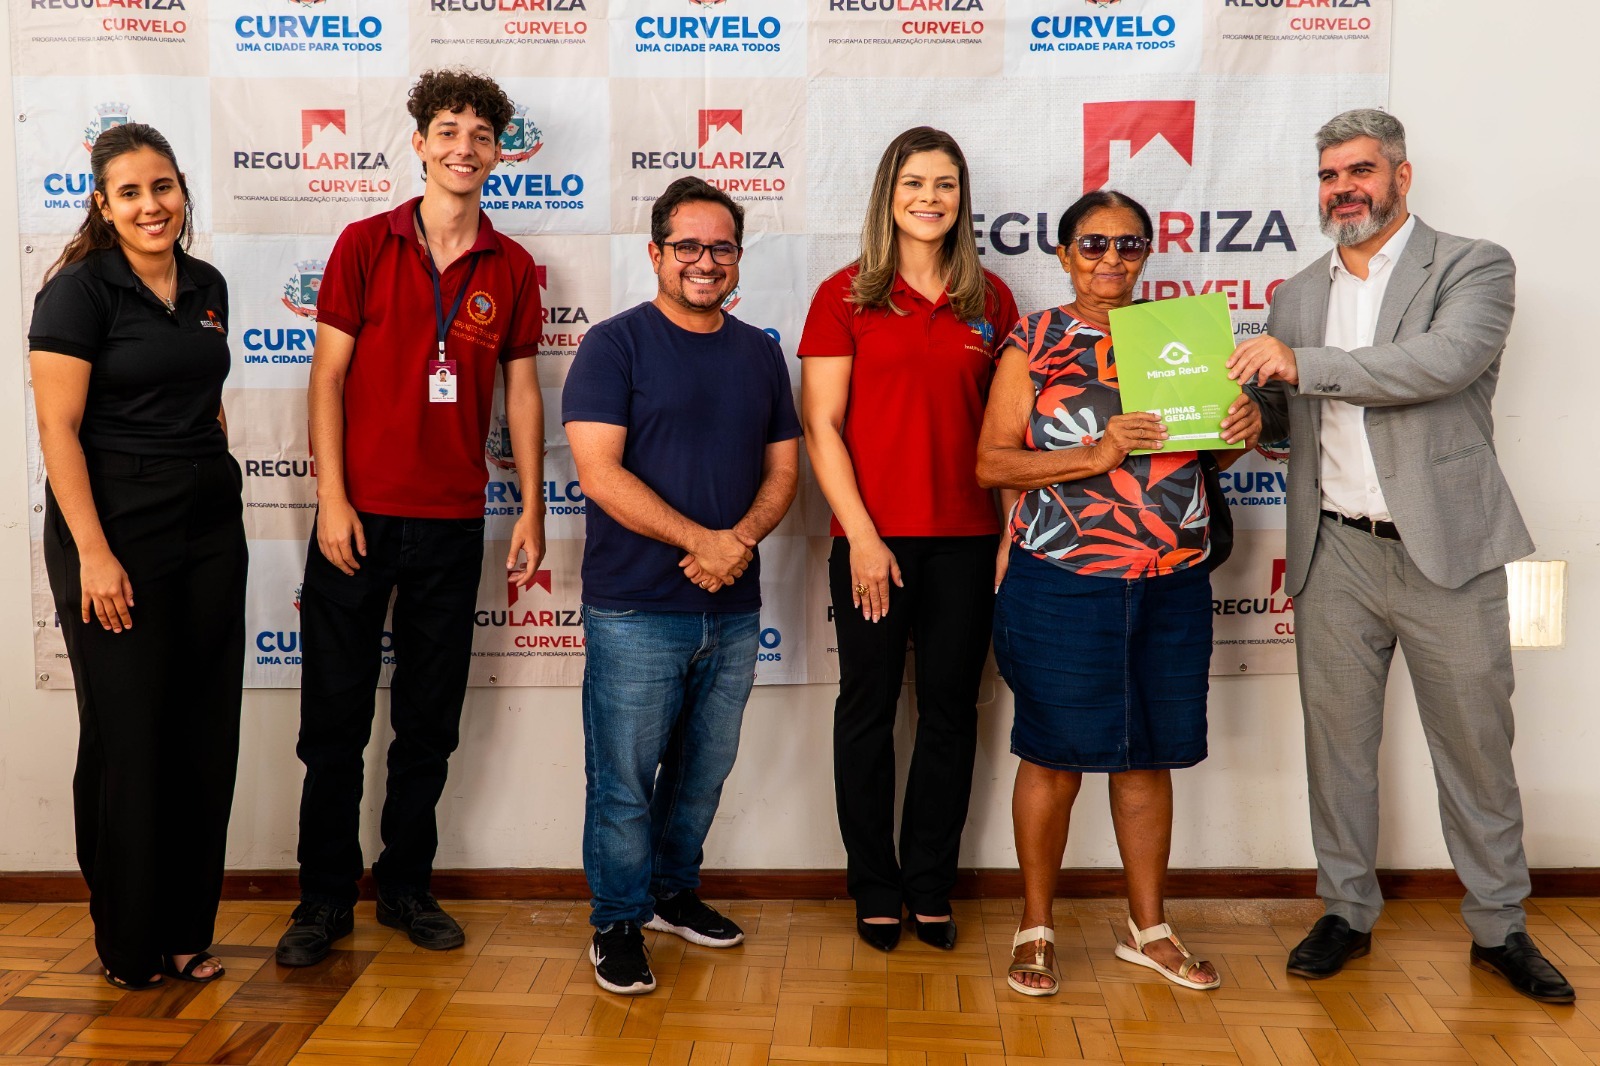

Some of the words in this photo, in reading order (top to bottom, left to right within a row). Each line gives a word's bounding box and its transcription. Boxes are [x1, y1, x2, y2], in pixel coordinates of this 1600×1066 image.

[102, 18, 187, 33] CURVELO
[235, 15, 382, 38] CURVELO
[504, 21, 588, 35] CURVELO
[635, 16, 781, 39] CURVELO
[901, 21, 984, 34] CURVELO
[1031, 15, 1176, 38] CURVELO
[1289, 17, 1371, 31] CURVELO
[236, 43, 262, 52] UMA
[264, 43, 306, 51] CIDADE
[309, 43, 340, 51] PARA
[343, 43, 382, 51] TODOS
[635, 43, 661, 52] UMA
[664, 43, 706, 52] CIDADE
[709, 43, 739, 52] PARA
[742, 43, 781, 52] TODOS
[1030, 43, 1055, 52] UMA
[1058, 42, 1100, 51] CIDADE
[1103, 42, 1133, 51] PARA
[1136, 40, 1176, 50] TODOS
[233, 151, 390, 170] REGULARIZA
[631, 151, 785, 170] REGULARIZA
[308, 179, 391, 193] CURVELO
[482, 173, 584, 196] RVELO
[44, 200, 71, 209] UMA
[480, 200, 509, 209] DADE
[512, 200, 542, 209] PARA
[545, 200, 584, 209] TODOS
[1233, 322, 1268, 335] URBA
[244, 355, 269, 364] UMA
[271, 355, 313, 364] CIDADE
[1146, 369, 1176, 380] Minas
[1178, 364, 1209, 376] Reurb
[1163, 405, 1196, 416] MINAS
[1164, 412, 1202, 422] GERAIS
[246, 460, 318, 477] REGUL
[1240, 496, 1282, 506] CIDADE
[484, 507, 513, 516] DADE
[549, 506, 586, 516] TODOS
[1211, 598, 1295, 616] REGULA
[474, 610, 584, 627] GULARIZ
[256, 656, 282, 665] UMA
